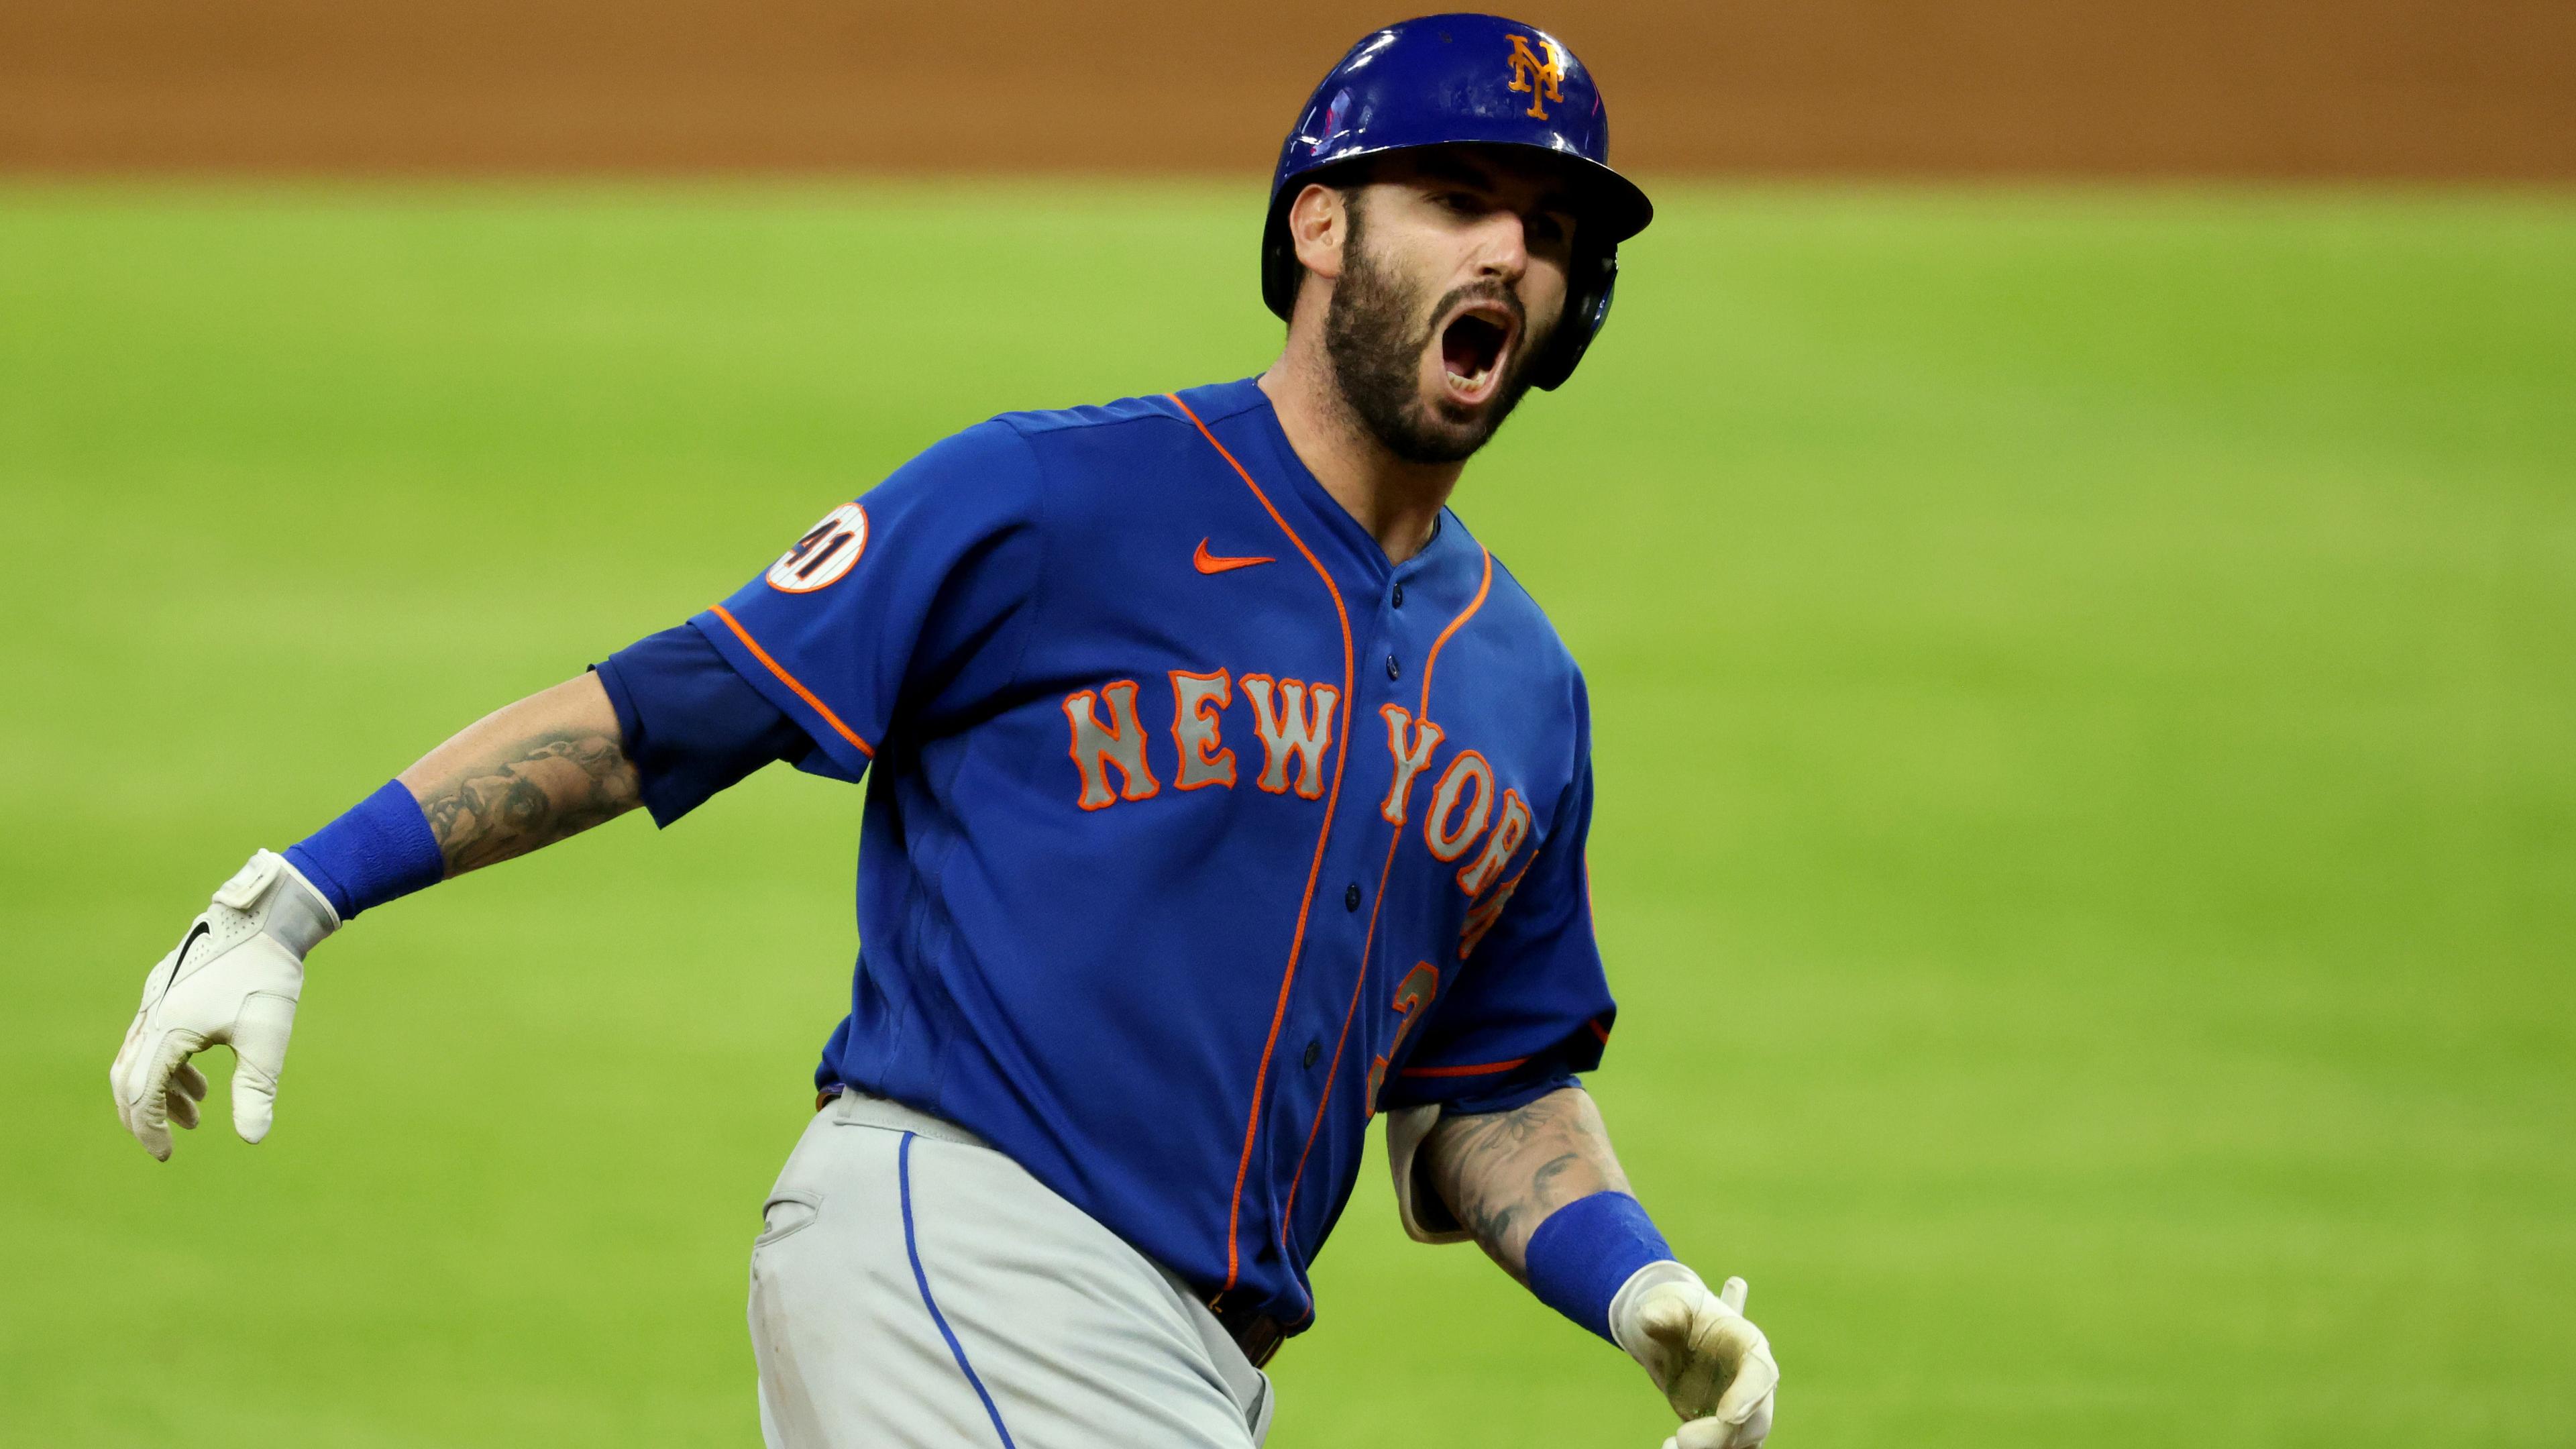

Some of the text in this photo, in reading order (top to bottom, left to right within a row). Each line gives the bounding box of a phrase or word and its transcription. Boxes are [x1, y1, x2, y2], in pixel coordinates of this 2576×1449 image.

[1505, 34, 1564, 121] NY
[784, 518, 855, 581] 41
[1061, 667, 1341, 811] NEW
